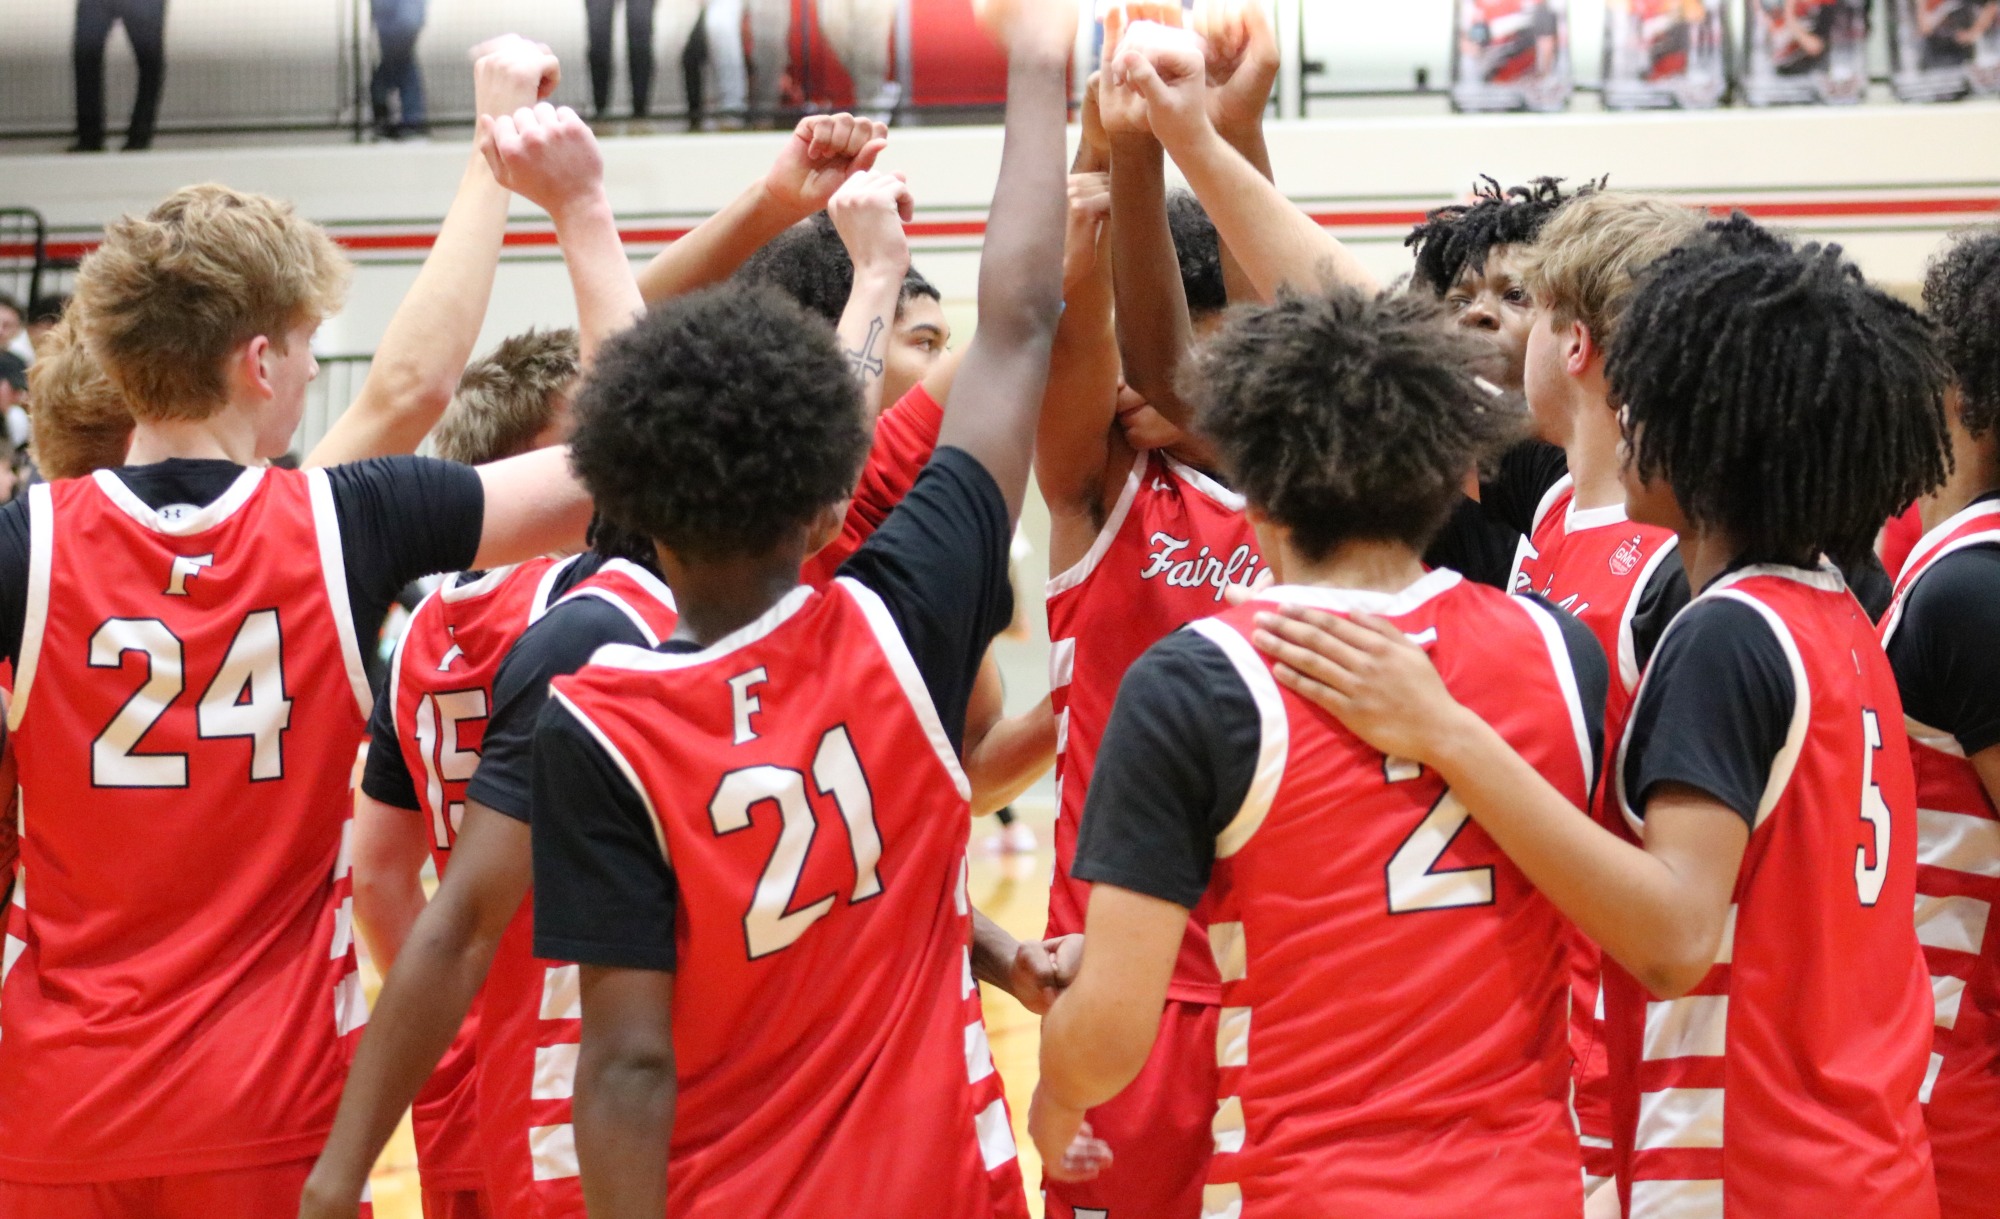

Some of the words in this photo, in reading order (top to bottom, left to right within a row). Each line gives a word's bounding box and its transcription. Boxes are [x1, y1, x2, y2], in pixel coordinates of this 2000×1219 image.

[162, 552, 215, 596] F
[1615, 547, 1637, 568] GMC
[87, 607, 293, 788] 24
[727, 665, 769, 746] F
[707, 721, 885, 961] 21
[1854, 705, 1892, 907] 5
